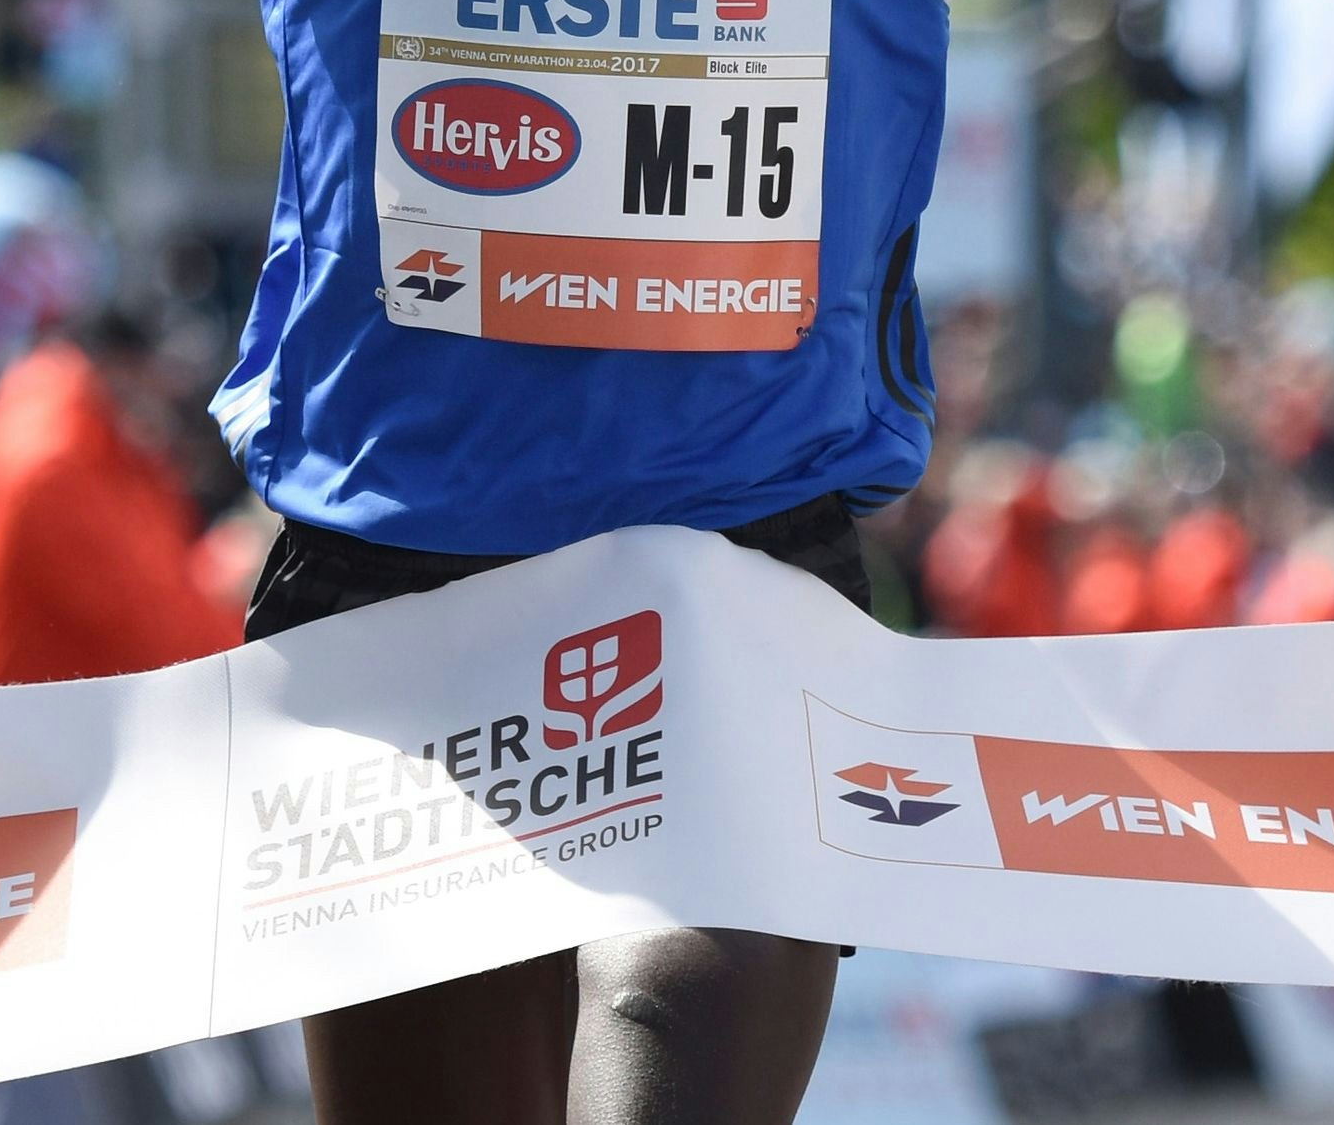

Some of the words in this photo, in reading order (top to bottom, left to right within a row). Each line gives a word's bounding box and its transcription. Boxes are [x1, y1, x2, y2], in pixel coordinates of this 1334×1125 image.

[451, 48, 487, 62] VIENNA
[489, 52, 512, 64] CITY
[513, 54, 574, 68] MARATHON
[714, 25, 767, 42] BANK
[709, 60, 739, 74] Block
[745, 61, 768, 74] Elite
[413, 101, 562, 170] Hervis
[623, 103, 798, 218] M-15
[499, 271, 618, 311] WIEN
[636, 278, 802, 313] ENERGIE
[252, 714, 531, 834] WIENER
[242, 730, 664, 891] STÄDTISCHE
[1019, 790, 1217, 841] WIEN
[242, 898, 359, 944] VIENNA
[369, 847, 548, 914] INSURANCE
[558, 813, 664, 863] GROUP
